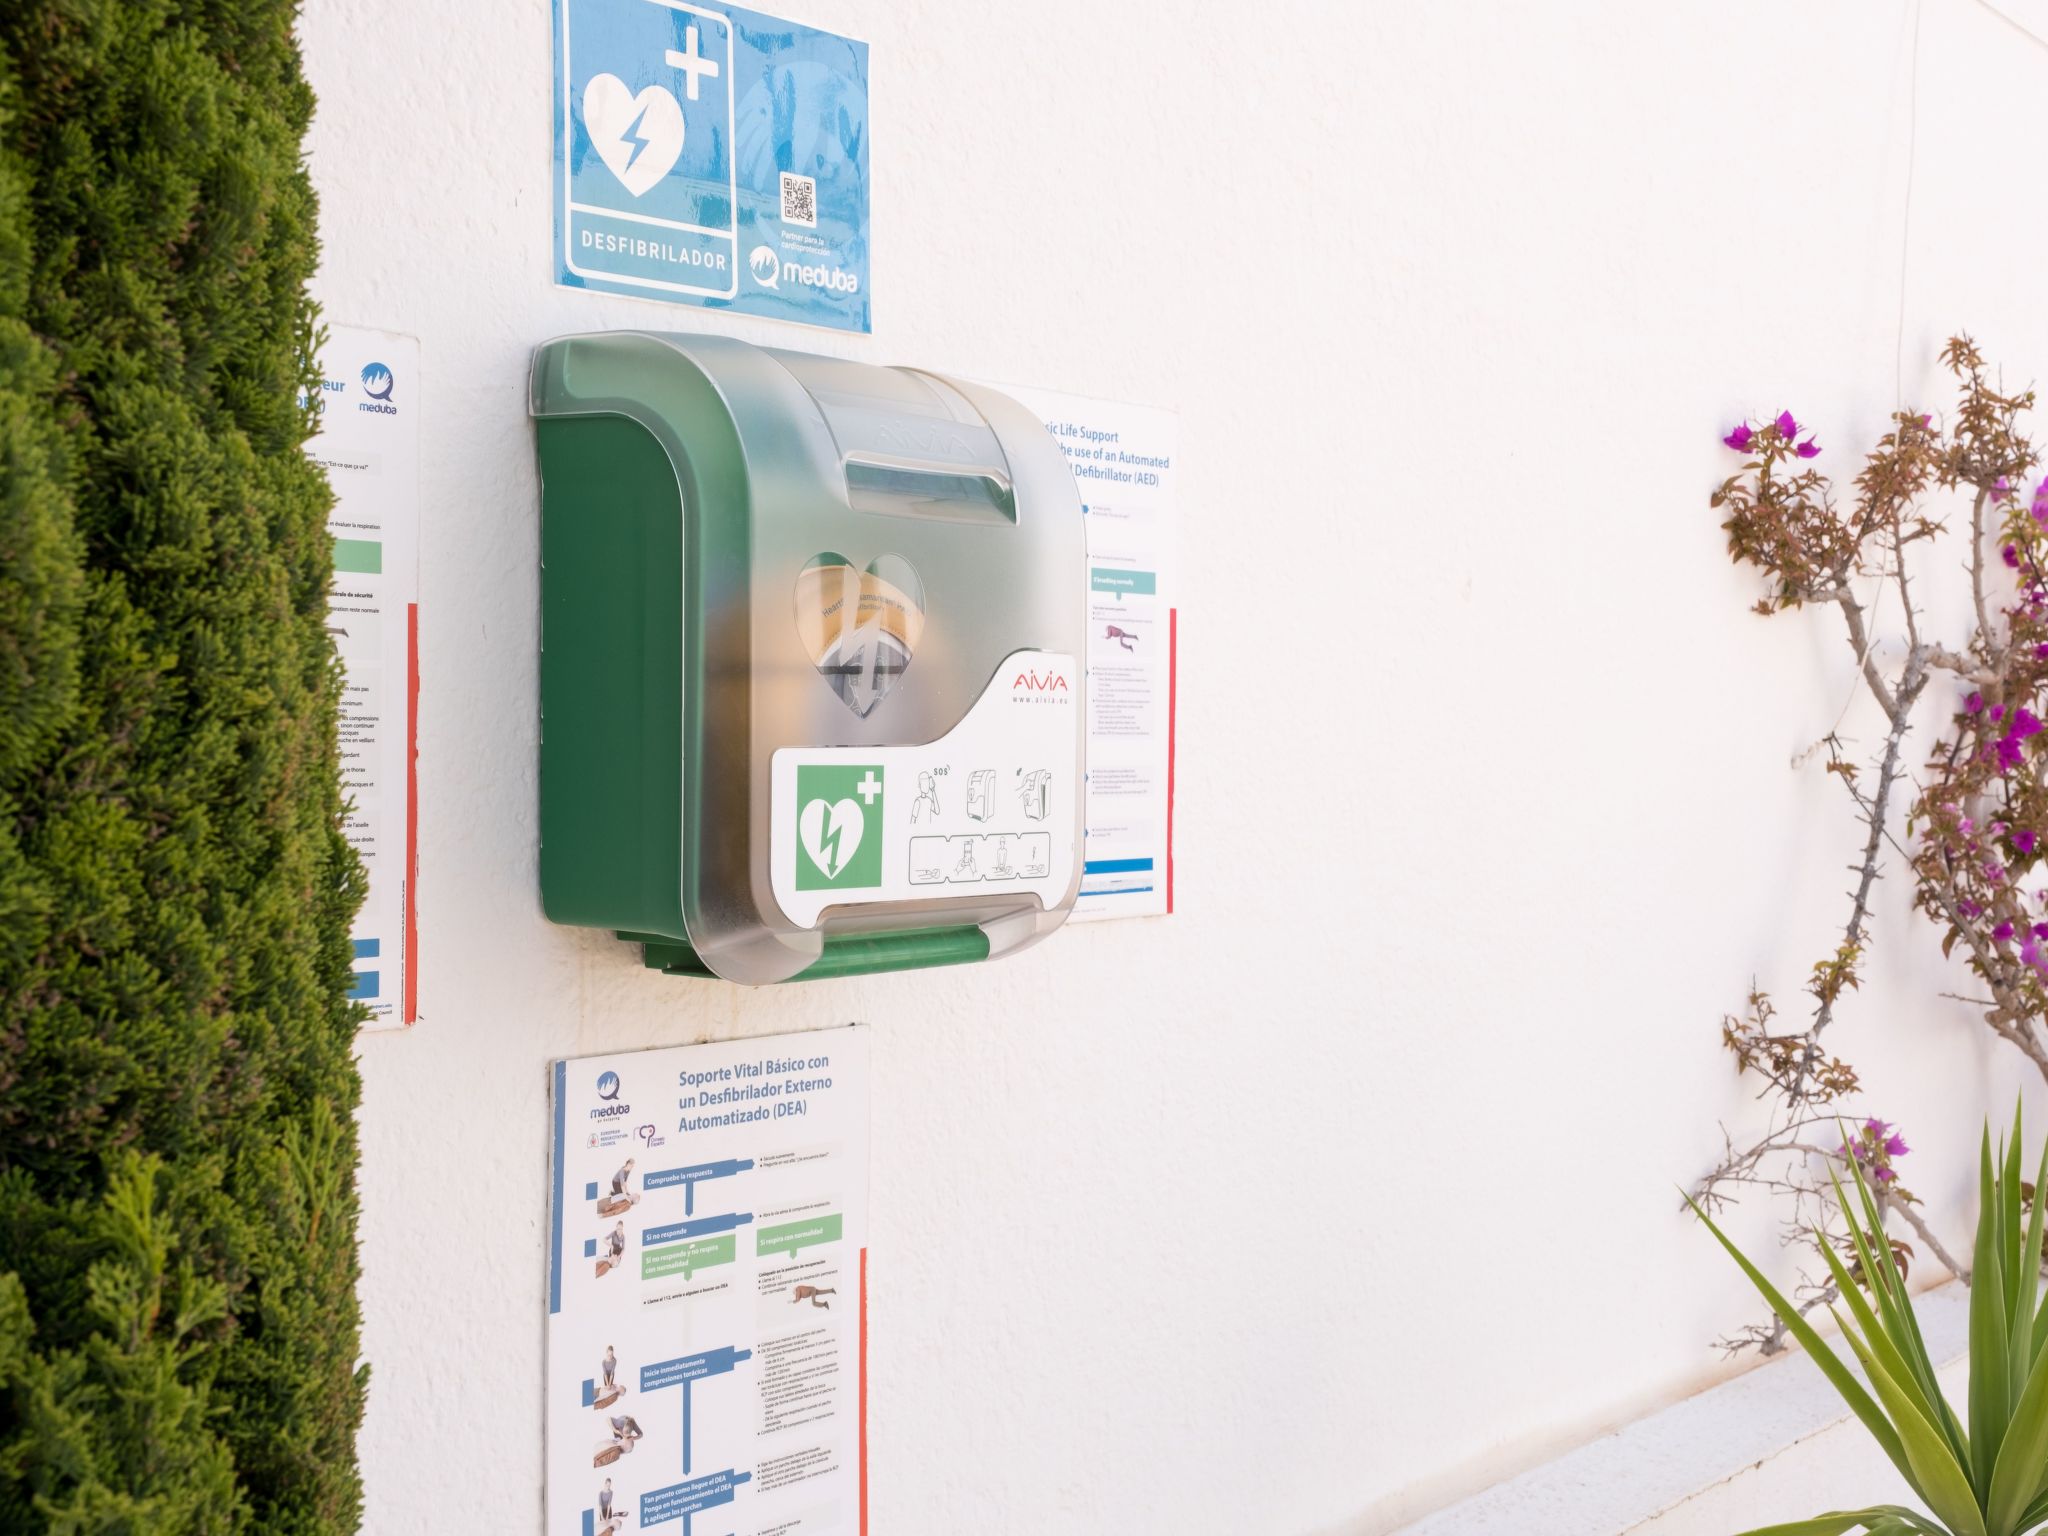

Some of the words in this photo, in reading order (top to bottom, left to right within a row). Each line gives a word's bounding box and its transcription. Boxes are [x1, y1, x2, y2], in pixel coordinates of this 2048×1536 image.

[781, 230, 803, 242] Partner
[804, 235, 818, 245] para
[581, 229, 726, 271] DESFIBRILADOR
[783, 262, 858, 293] meduba
[359, 402, 397, 415] meduba
[1060, 422, 1078, 438] Life
[1080, 425, 1119, 444] Support
[1074, 447, 1091, 459] use
[1093, 447, 1104, 460] of
[1105, 451, 1117, 462] an
[1119, 451, 1170, 469] Automated
[1074, 463, 1132, 483] Defibrillator
[1134, 471, 1160, 488] (AED)
[822, 597, 844, 618] Heart
[933, 767, 948, 776] SOS
[679, 1067, 732, 1088] Soporte
[734, 1060, 763, 1079] Vital
[766, 1057, 805, 1075] Básico
[808, 1055, 829, 1069] con
[679, 1097, 696, 1109] un
[699, 1082, 783, 1107] Desfibrilador
[785, 1077, 833, 1094] Externo
[590, 1103, 630, 1119] meduba
[678, 1105, 770, 1133] Automatizado
[773, 1099, 807, 1120] (DEA)
[647, 1174, 680, 1186] Compruebe
[680, 1171, 686, 1179] la
[686, 1168, 713, 1180] respuesta
[646, 1233, 652, 1241] Si
[652, 1232, 660, 1240] no
[660, 1227, 687, 1239] responde
[794, 1227, 824, 1239] normalidad
[646, 1256, 652, 1264] Si
[660, 1250, 687, 1262] responde
[699, 1244, 719, 1254] respira
[645, 1266, 656, 1274] con
[656, 1259, 689, 1272] normalidad
[643, 1374, 683, 1388] compresiones
[683, 1367, 708, 1379] torácicas
[644, 1368, 659, 1378] Inicie
[660, 1358, 706, 1374] inmediatamente
[644, 1496, 655, 1504] Tan
[655, 1491, 675, 1502] pronto
[675, 1486, 691, 1496] como
[691, 1481, 709, 1491] llegue
[709, 1477, 714, 1485] el
[714, 1474, 727, 1484] DEA
[644, 1505, 662, 1514] Ponga
[671, 1489, 714, 1507] funcionamiento
[720, 1483, 732, 1492] DEA
[650, 1512, 671, 1523] aplique
[671, 1508, 680, 1516] los
[680, 1502, 702, 1515] parches
